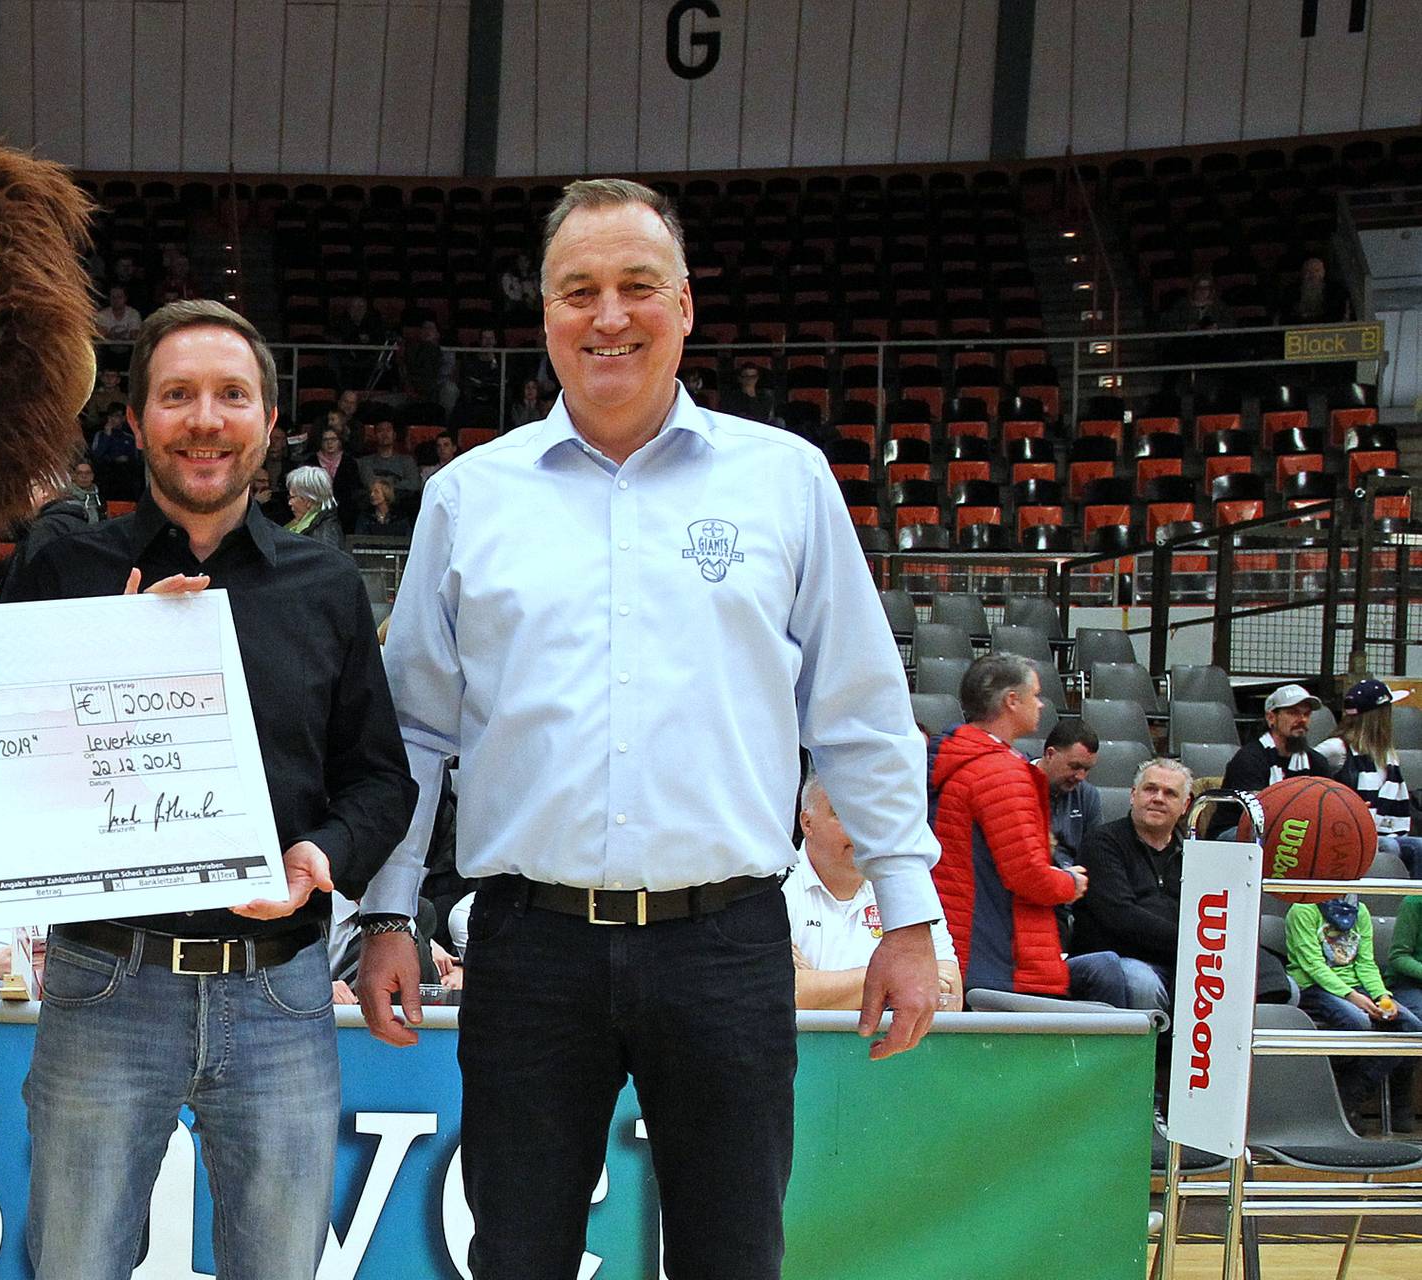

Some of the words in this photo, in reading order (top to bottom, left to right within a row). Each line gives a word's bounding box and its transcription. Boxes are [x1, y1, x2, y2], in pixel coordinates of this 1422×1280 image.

[667, 0, 721, 80] G
[1288, 333, 1347, 354] Block
[1361, 328, 1379, 350] B
[698, 536, 729, 553] GIANTS
[87, 730, 173, 752] Leverkusen
[0, 881, 27, 890] Angabe
[27, 879, 46, 887] einer
[46, 875, 91, 885] Zahlungsfrist
[120, 869, 143, 878] Scheck
[144, 868, 157, 877] gilt
[167, 865, 185, 873] nicht
[185, 862, 226, 873] geschrieben.
[220, 871, 236, 879] Text
[36, 888, 62, 897] Betrag
[1189, 889, 1229, 1090] Wilson
